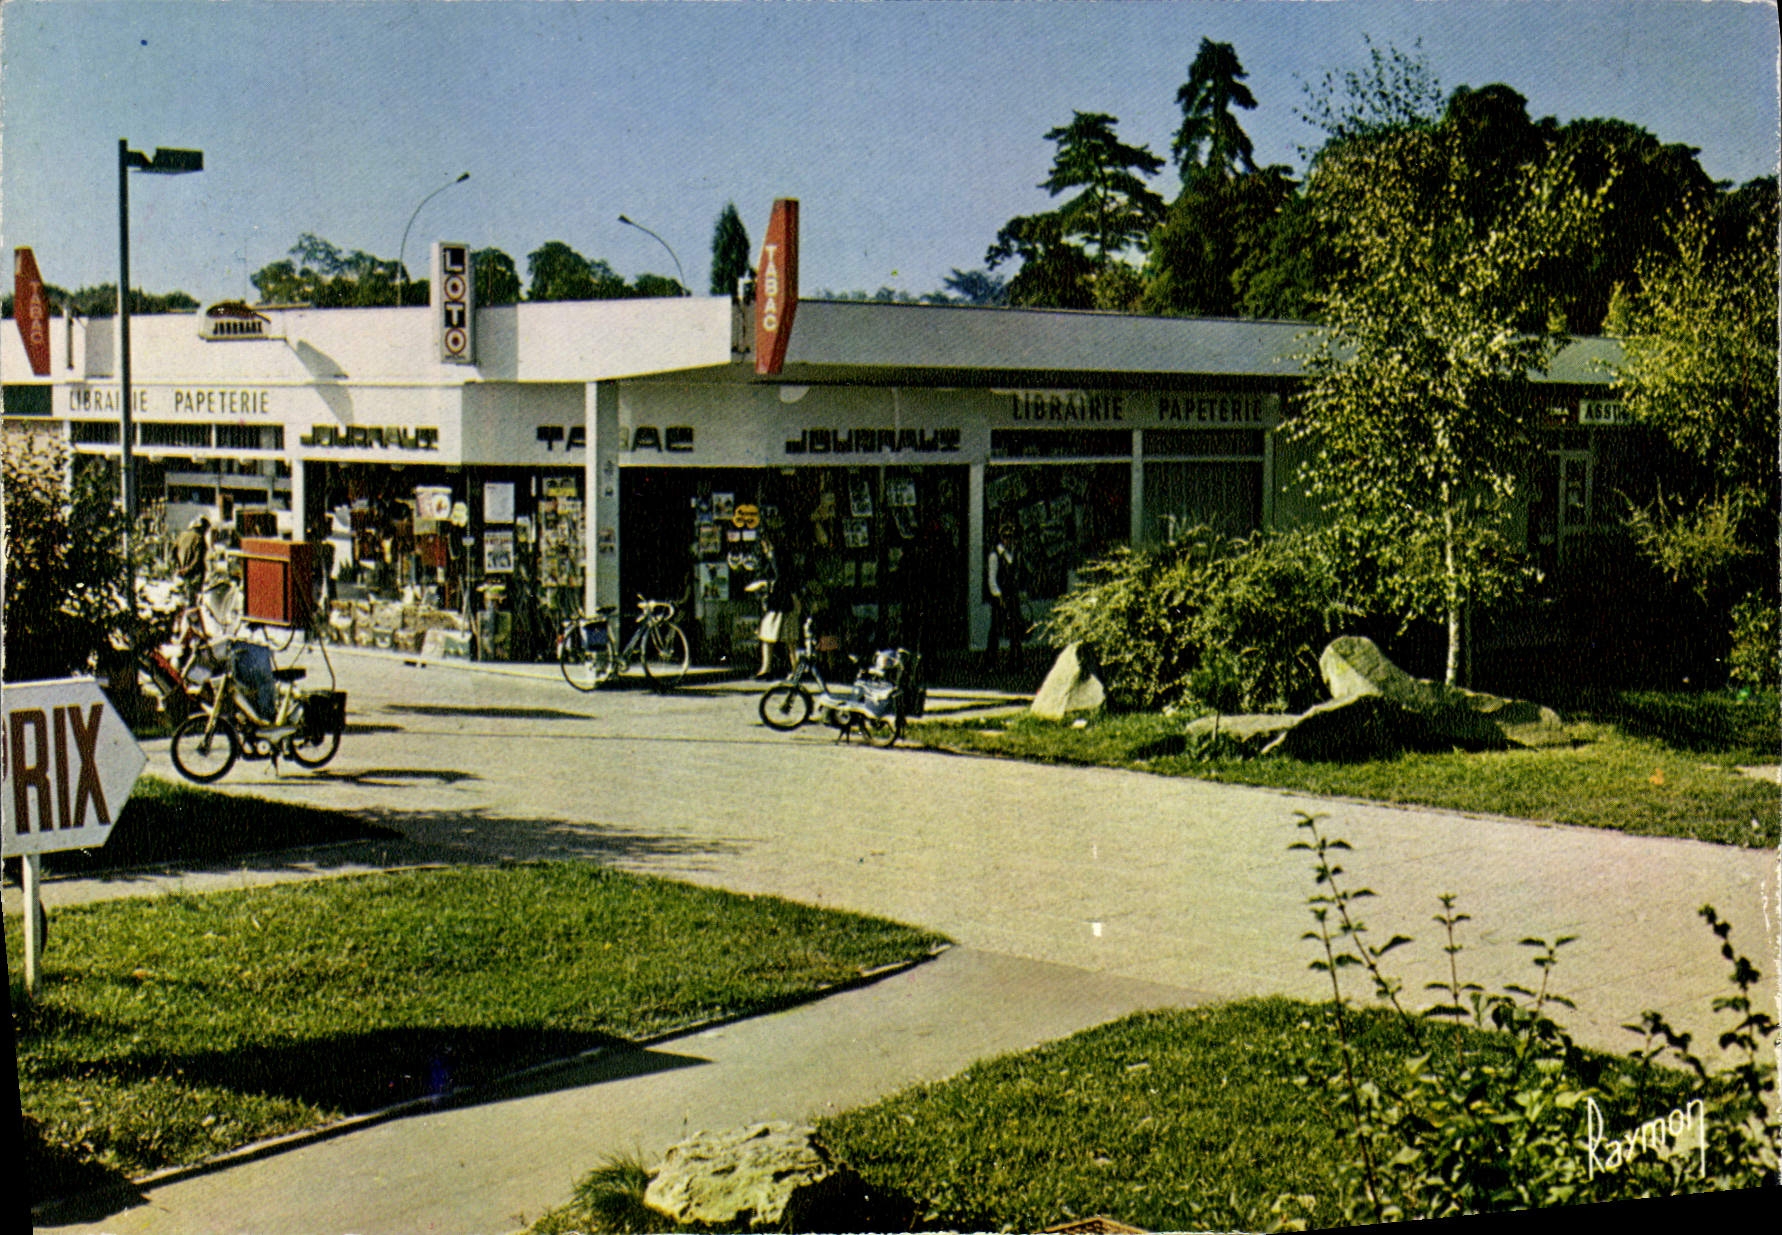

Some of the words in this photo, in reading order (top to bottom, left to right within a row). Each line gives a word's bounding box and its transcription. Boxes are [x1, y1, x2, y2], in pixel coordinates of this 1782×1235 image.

[443, 246, 467, 354] LOTO
[760, 245, 778, 332] TABAC
[29, 281, 44, 345] TABAC
[69, 389, 148, 412] LIBRAIIE
[174, 390, 269, 414] PAPETERIE
[1012, 393, 1123, 421] LIBRAIRIE
[1158, 396, 1263, 422] PAPETERIE
[299, 424, 439, 451] JOURNAUX
[536, 425, 694, 453] TAAC
[785, 428, 961, 454] JOURNAUX
[3, 702, 112, 836] RIX
